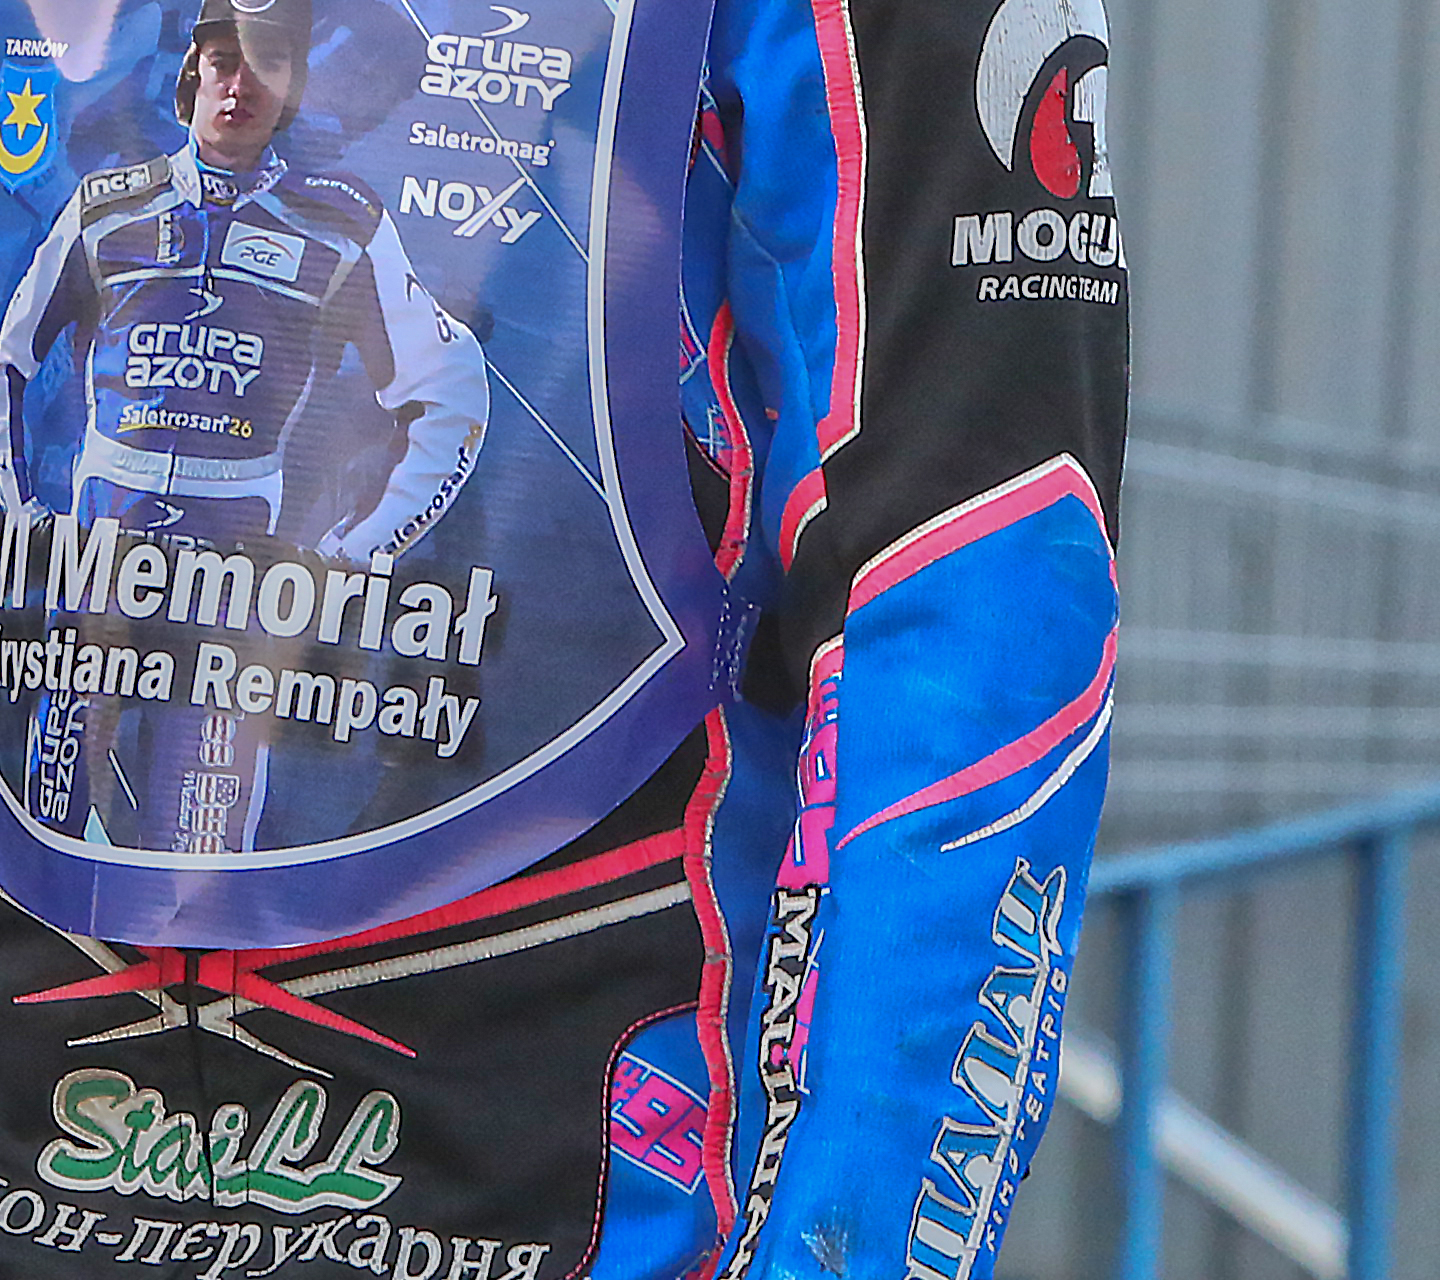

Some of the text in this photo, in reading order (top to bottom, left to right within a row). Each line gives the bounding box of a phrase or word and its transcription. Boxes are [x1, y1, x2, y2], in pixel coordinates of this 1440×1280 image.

[239, 245, 282, 267] PGE
[46, 513, 497, 666] Memoriał
[192, 642, 479, 758] Rempały
